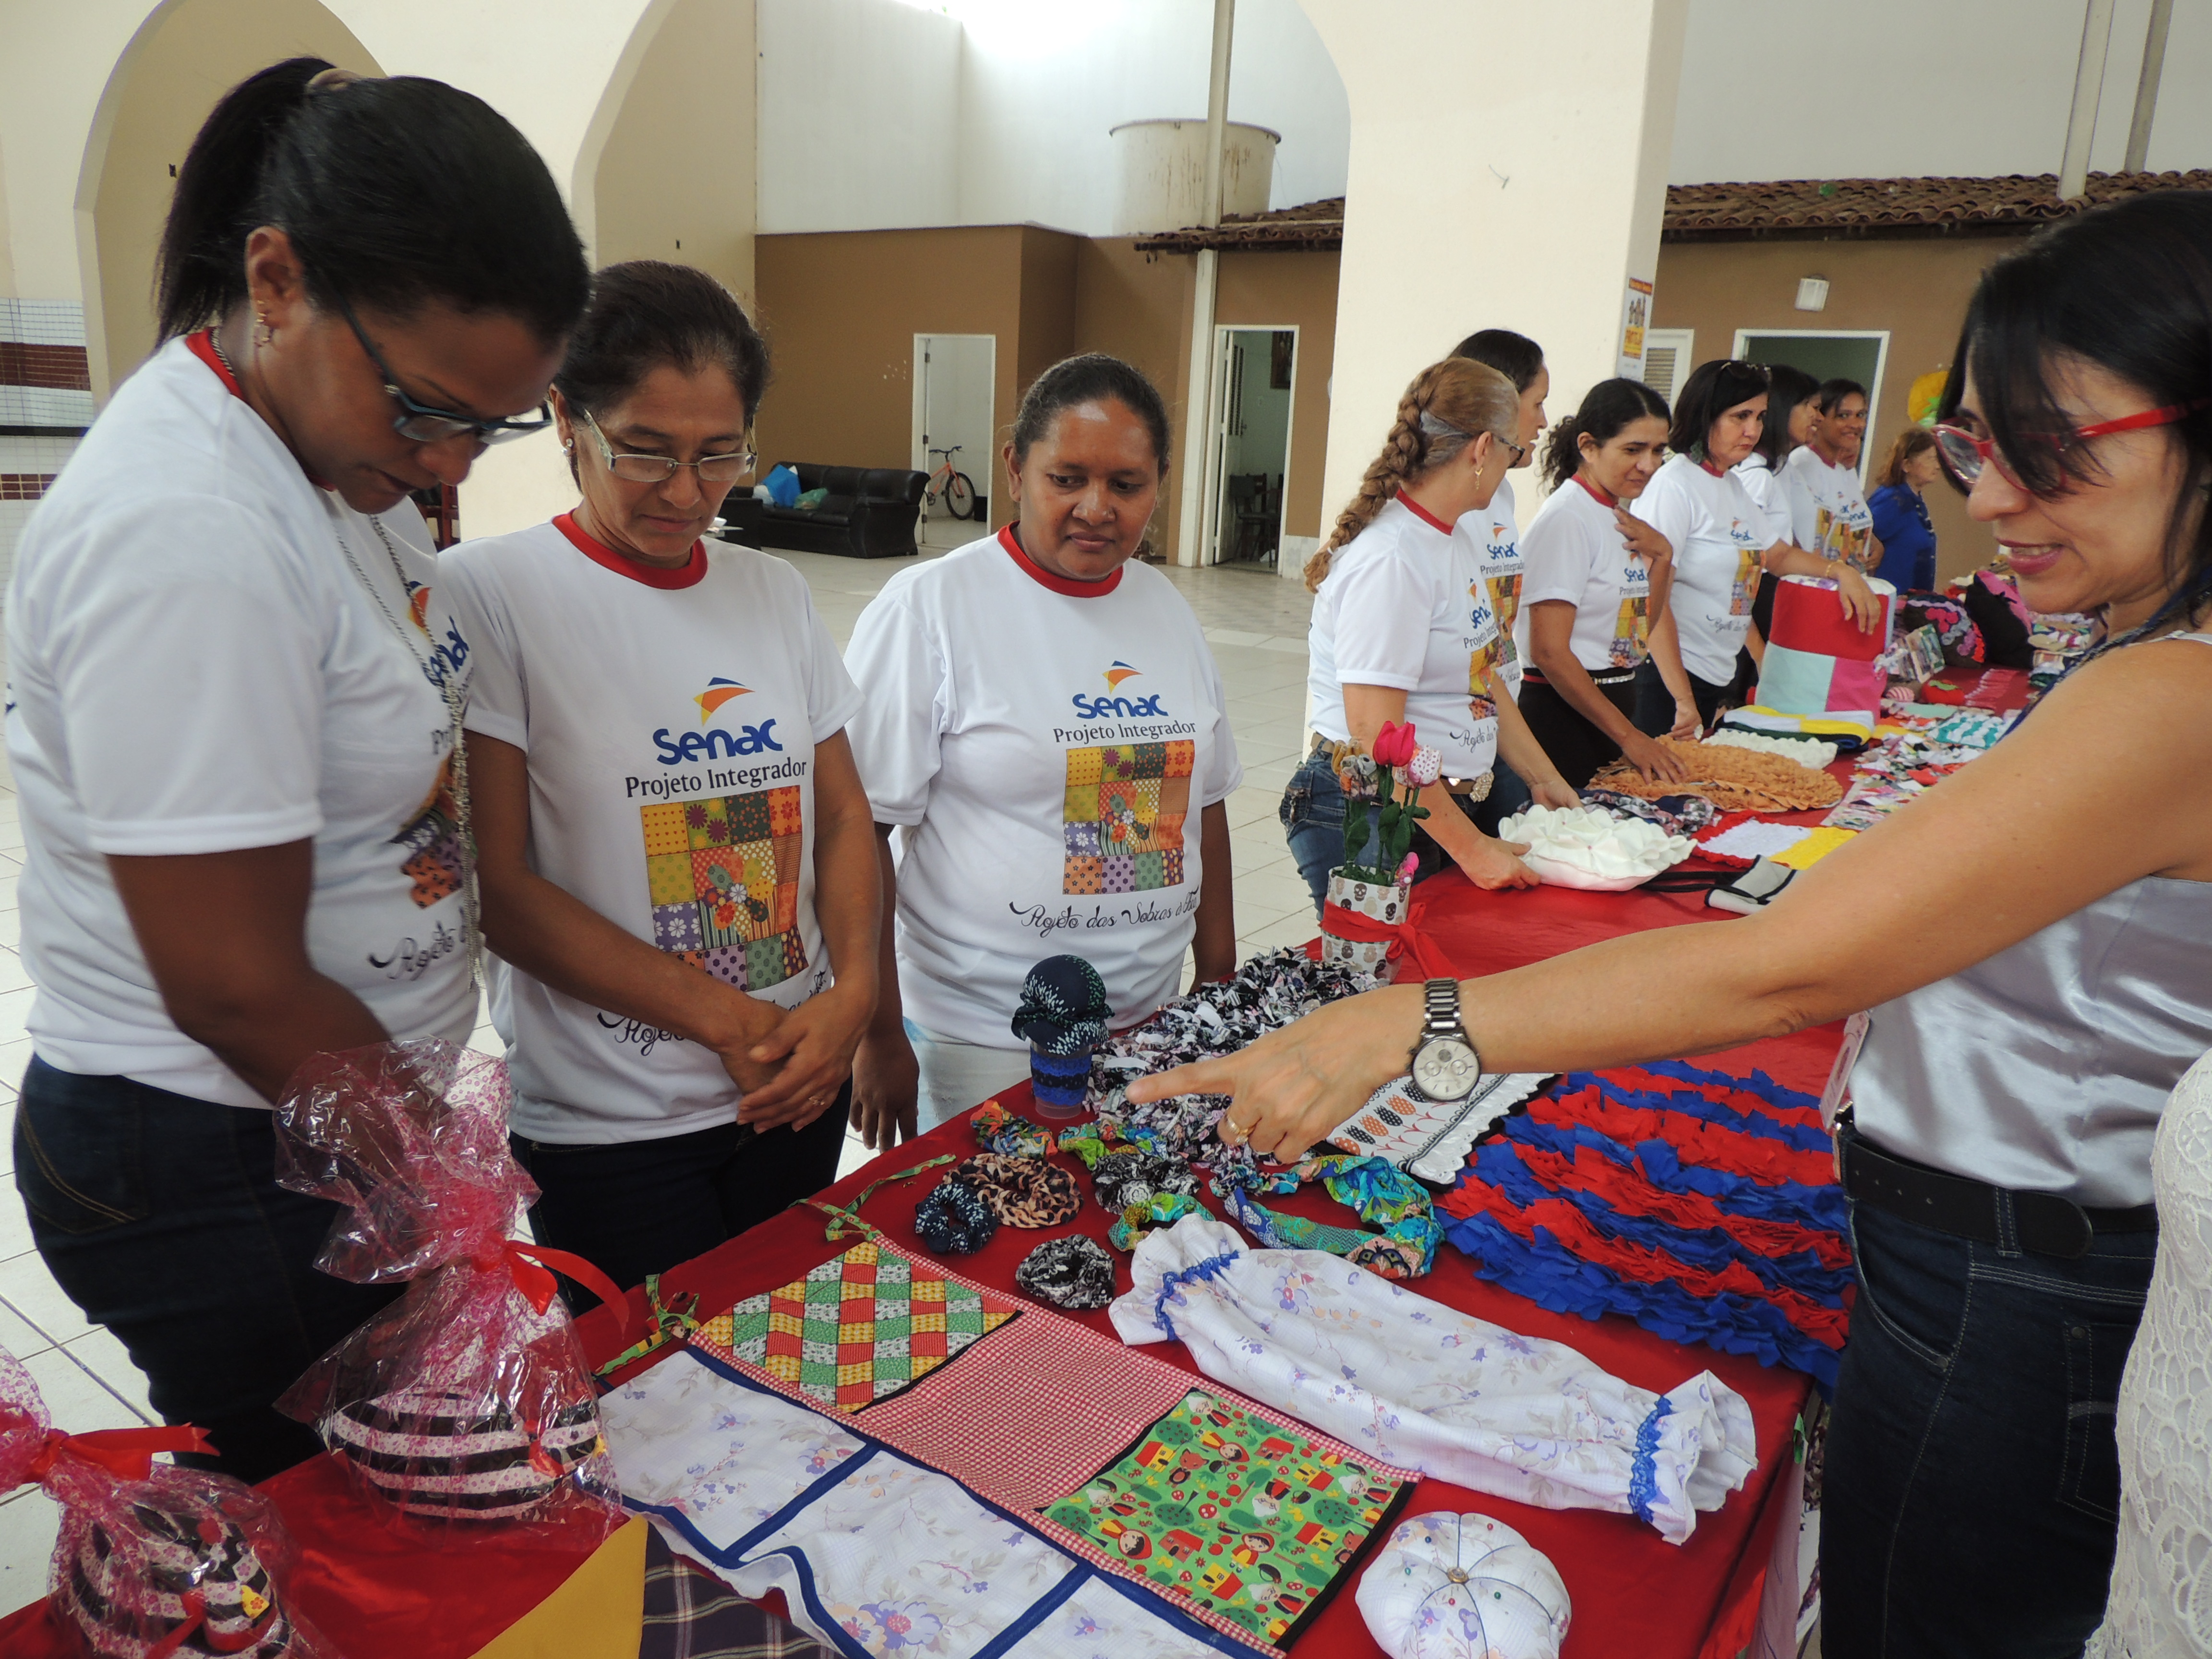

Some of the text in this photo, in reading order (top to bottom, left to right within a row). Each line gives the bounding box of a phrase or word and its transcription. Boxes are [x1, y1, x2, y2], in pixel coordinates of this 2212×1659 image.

[1072, 694, 1169, 719] Senac
[653, 719, 783, 765] Senac
[1053, 720, 1196, 745] Projeto Integrador
[625, 757, 807, 800] Projeto Integrador
[1009, 902, 1083, 938] Projeto
[1086, 905, 1117, 928] das
